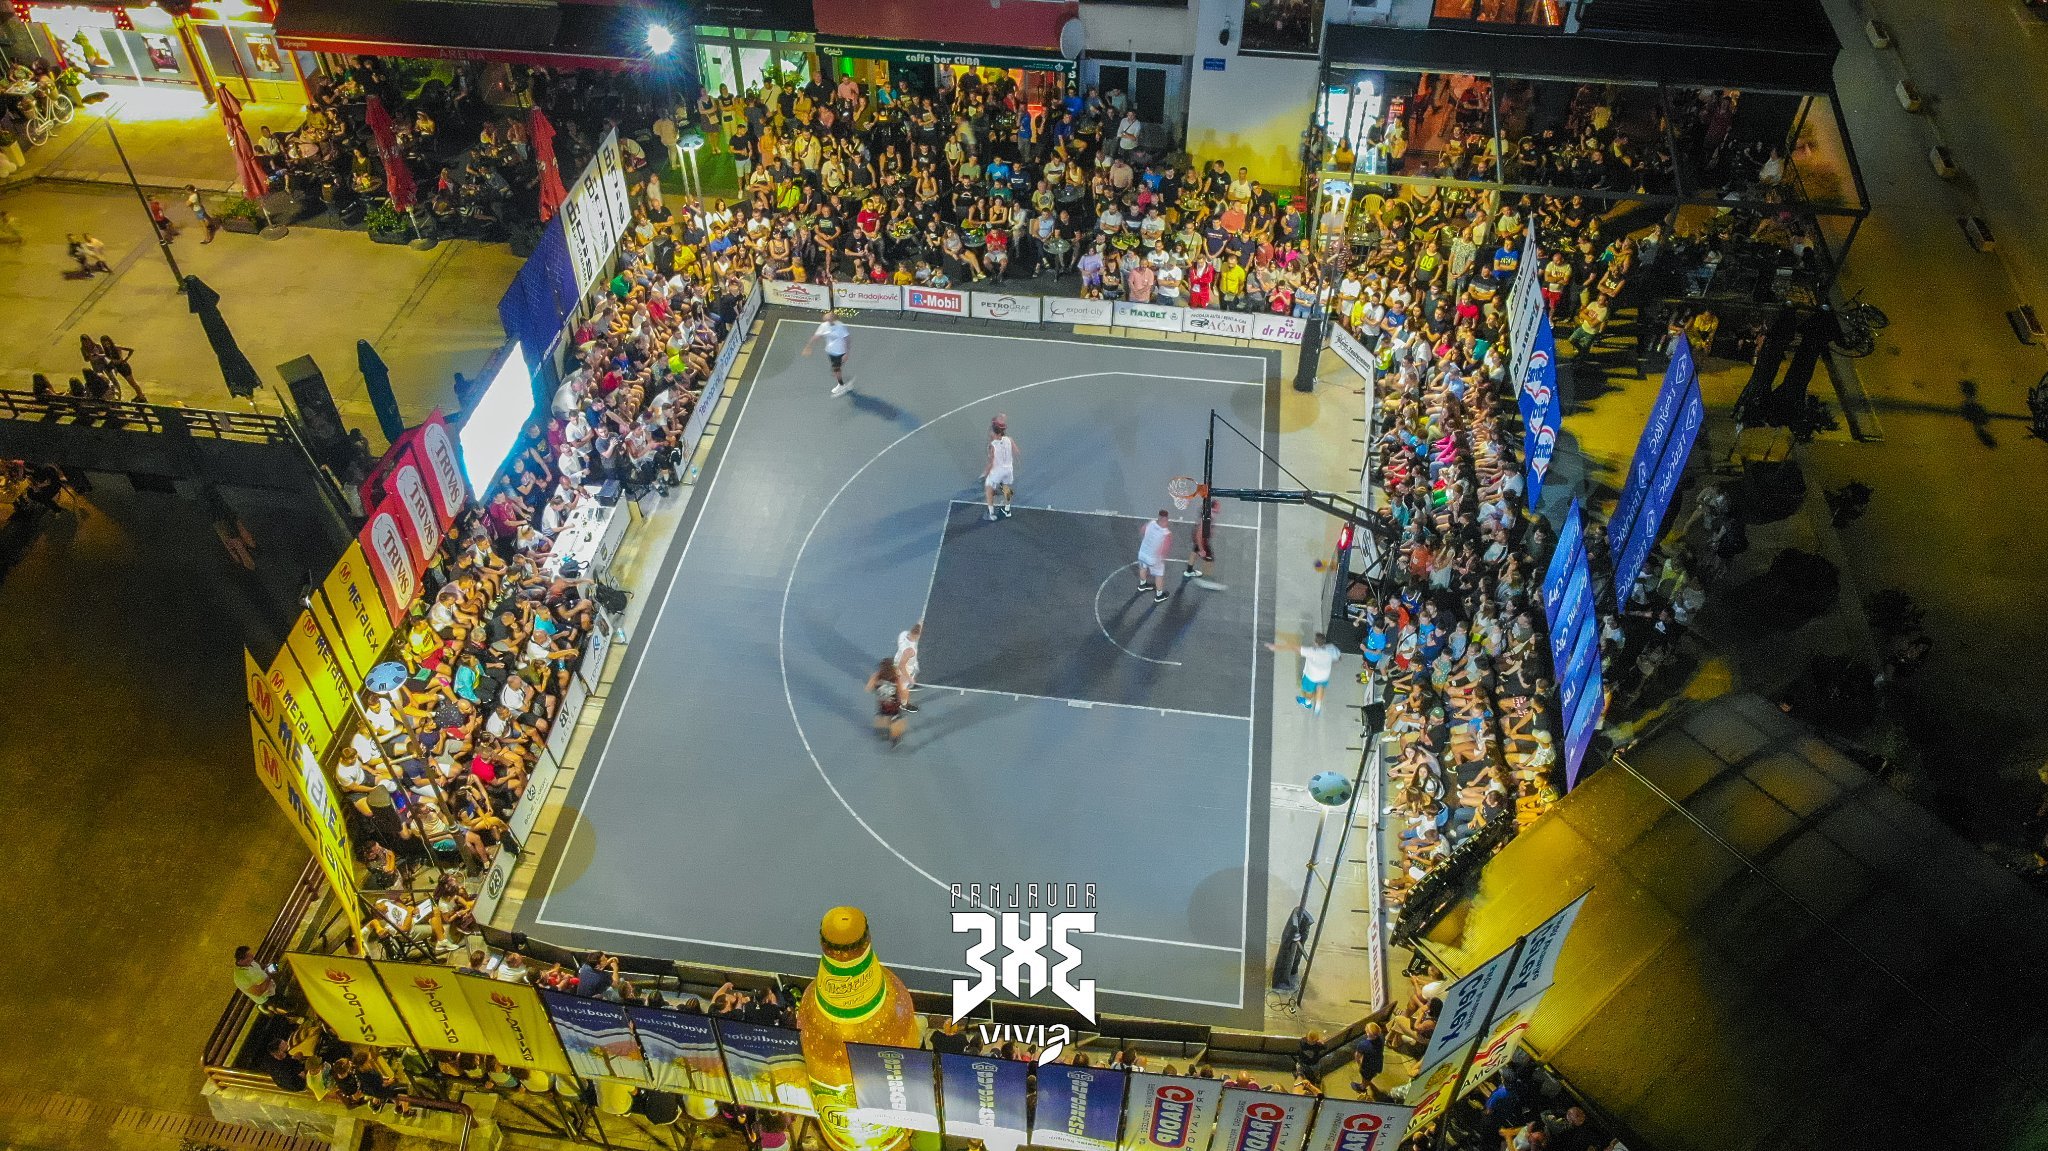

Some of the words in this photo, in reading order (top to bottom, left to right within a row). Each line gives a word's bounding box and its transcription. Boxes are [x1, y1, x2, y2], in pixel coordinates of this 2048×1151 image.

[905, 53, 931, 64] caffe
[933, 54, 952, 65] bar
[954, 55, 980, 66] CUBA
[848, 290, 858, 299] dr
[912, 291, 959, 310] R-Mobil
[1262, 326, 1275, 338] dr
[1277, 326, 1304, 341] Pržu
[435, 439, 461, 504] TRIVAS
[409, 481, 435, 546] TRIVAS
[383, 529, 410, 595] TRIVAS
